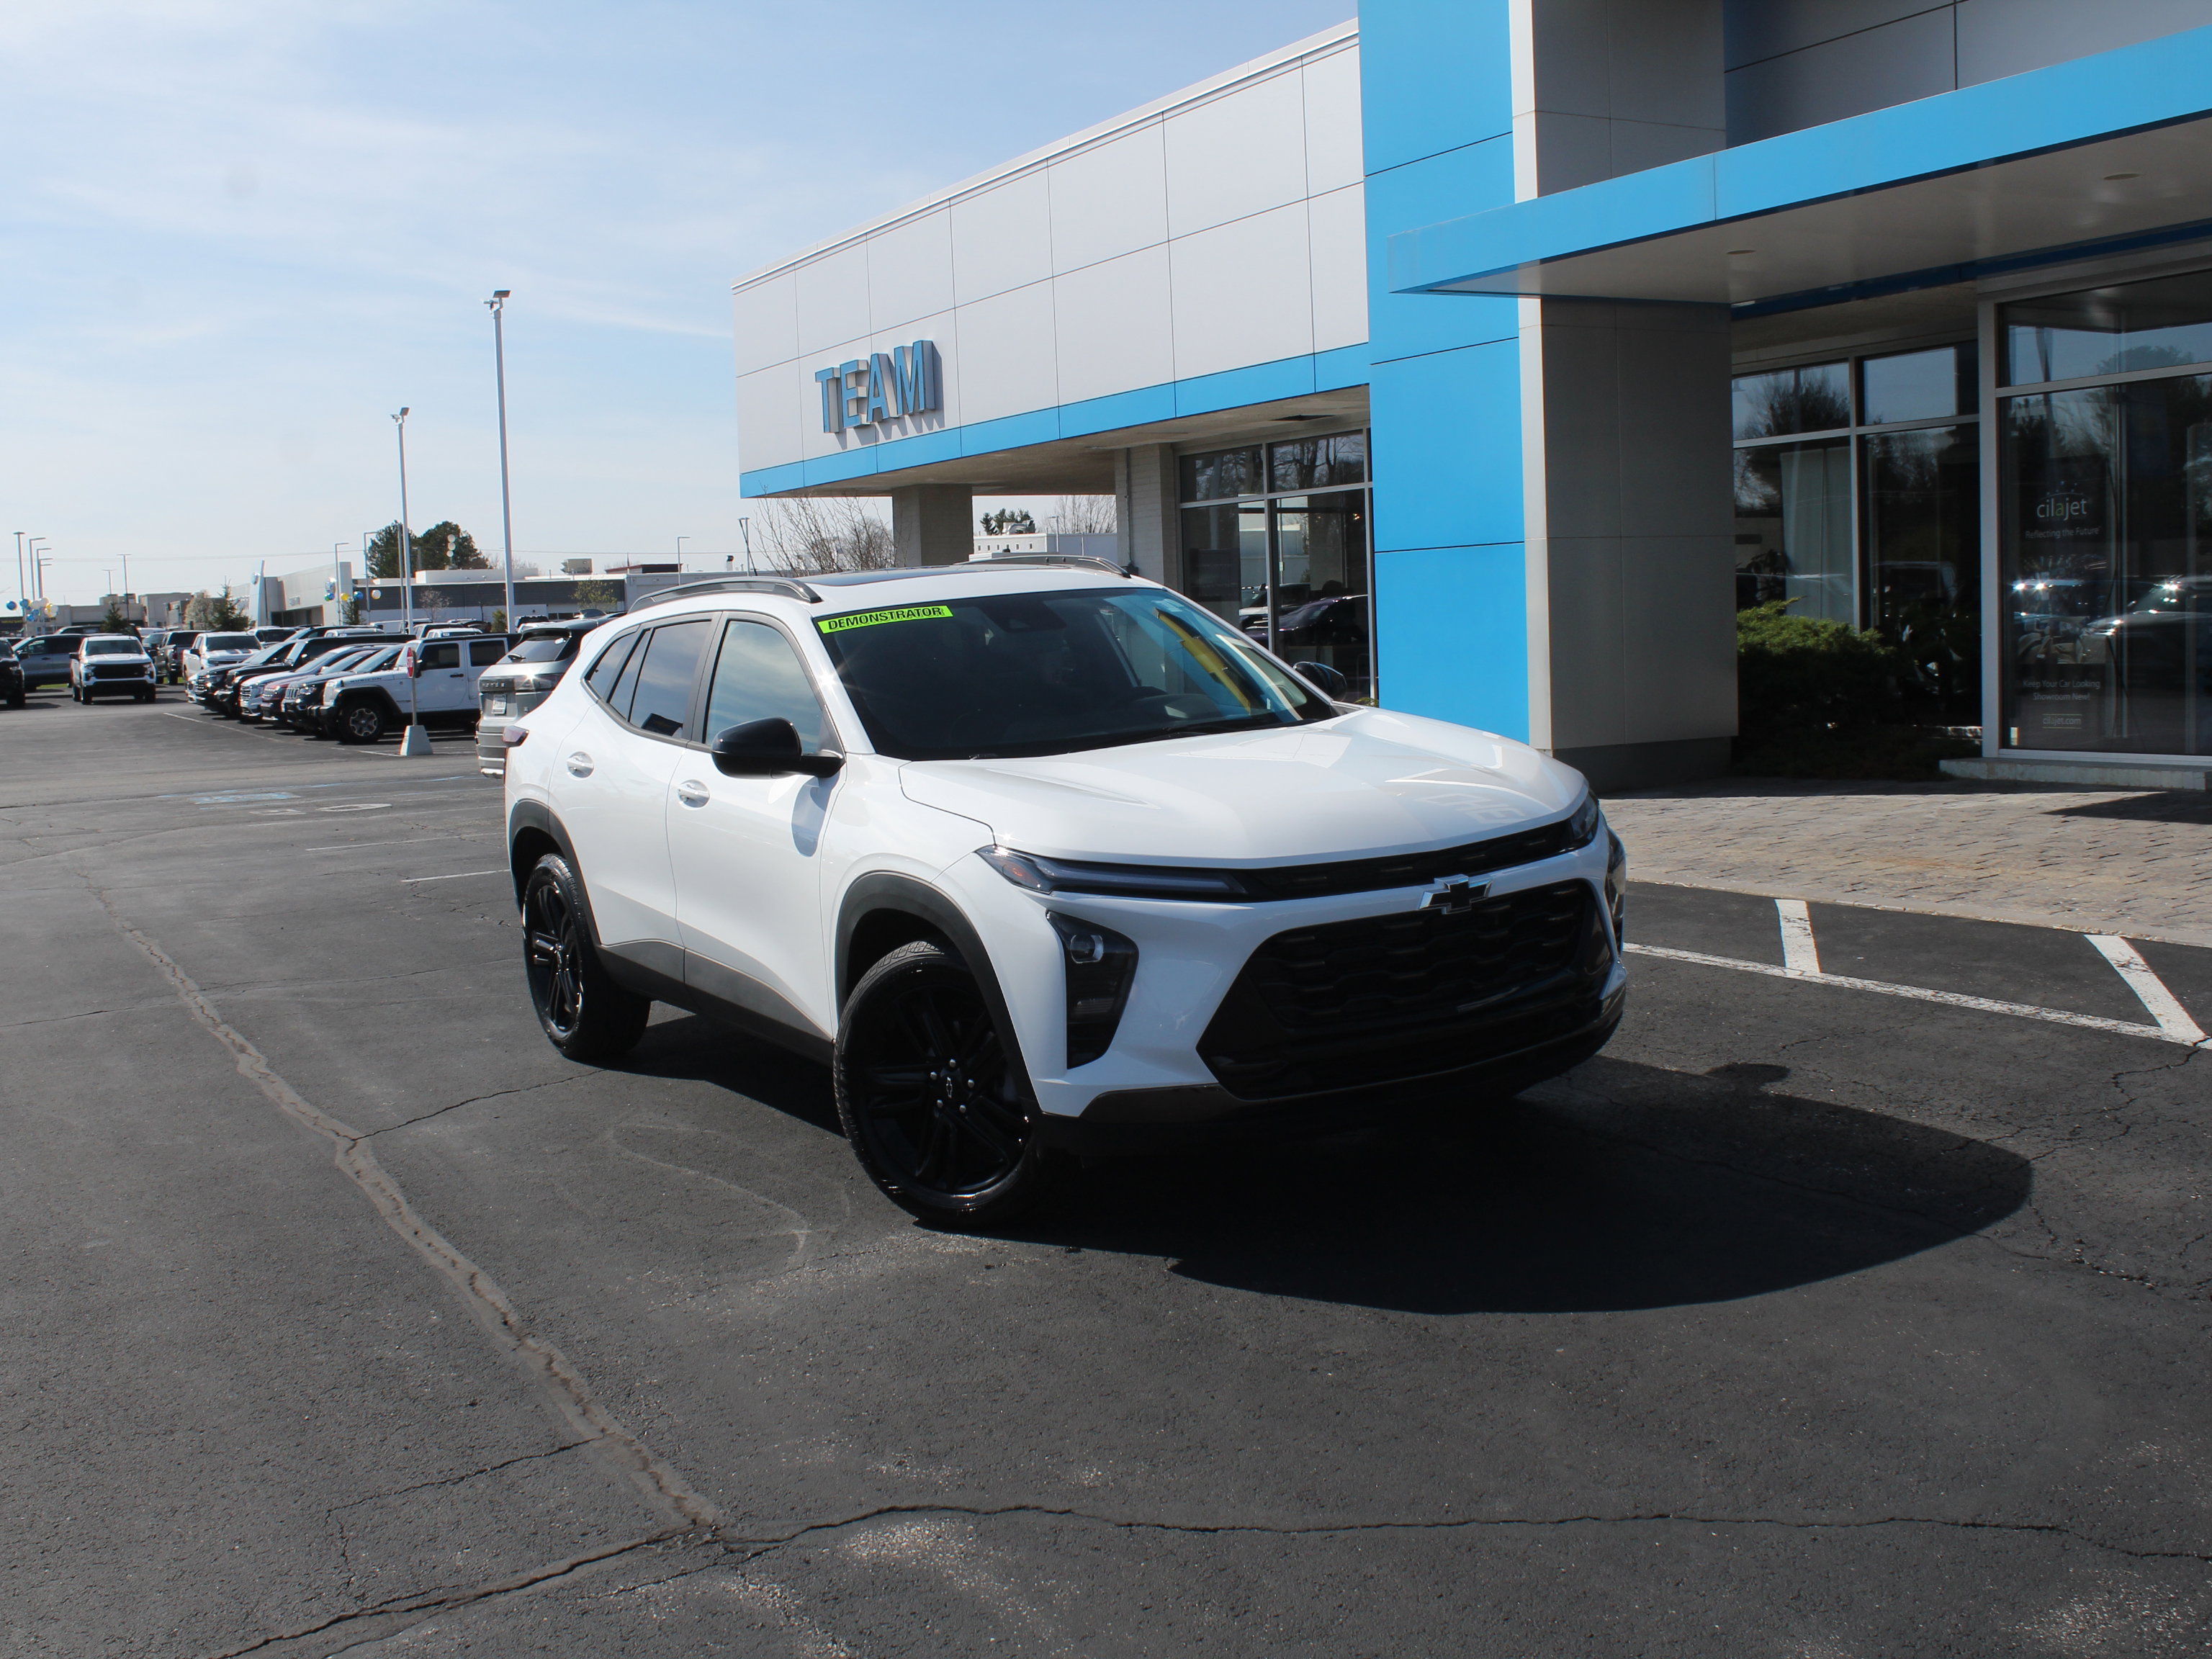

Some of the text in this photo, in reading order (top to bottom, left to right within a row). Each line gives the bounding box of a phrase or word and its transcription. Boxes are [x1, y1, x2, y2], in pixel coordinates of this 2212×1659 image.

[814, 340, 934, 433] TEAM
[2036, 498, 2087, 521] cilajet
[2025, 527, 2099, 539] Reflecting the Future
[828, 607, 942, 629] DEMONSTRATOR
[2023, 680, 2041, 688] Keep
[2072, 679, 2100, 689] Looking
[2033, 692, 2090, 701] Showroom New!
[2042, 716, 2082, 726] cilajet.com
